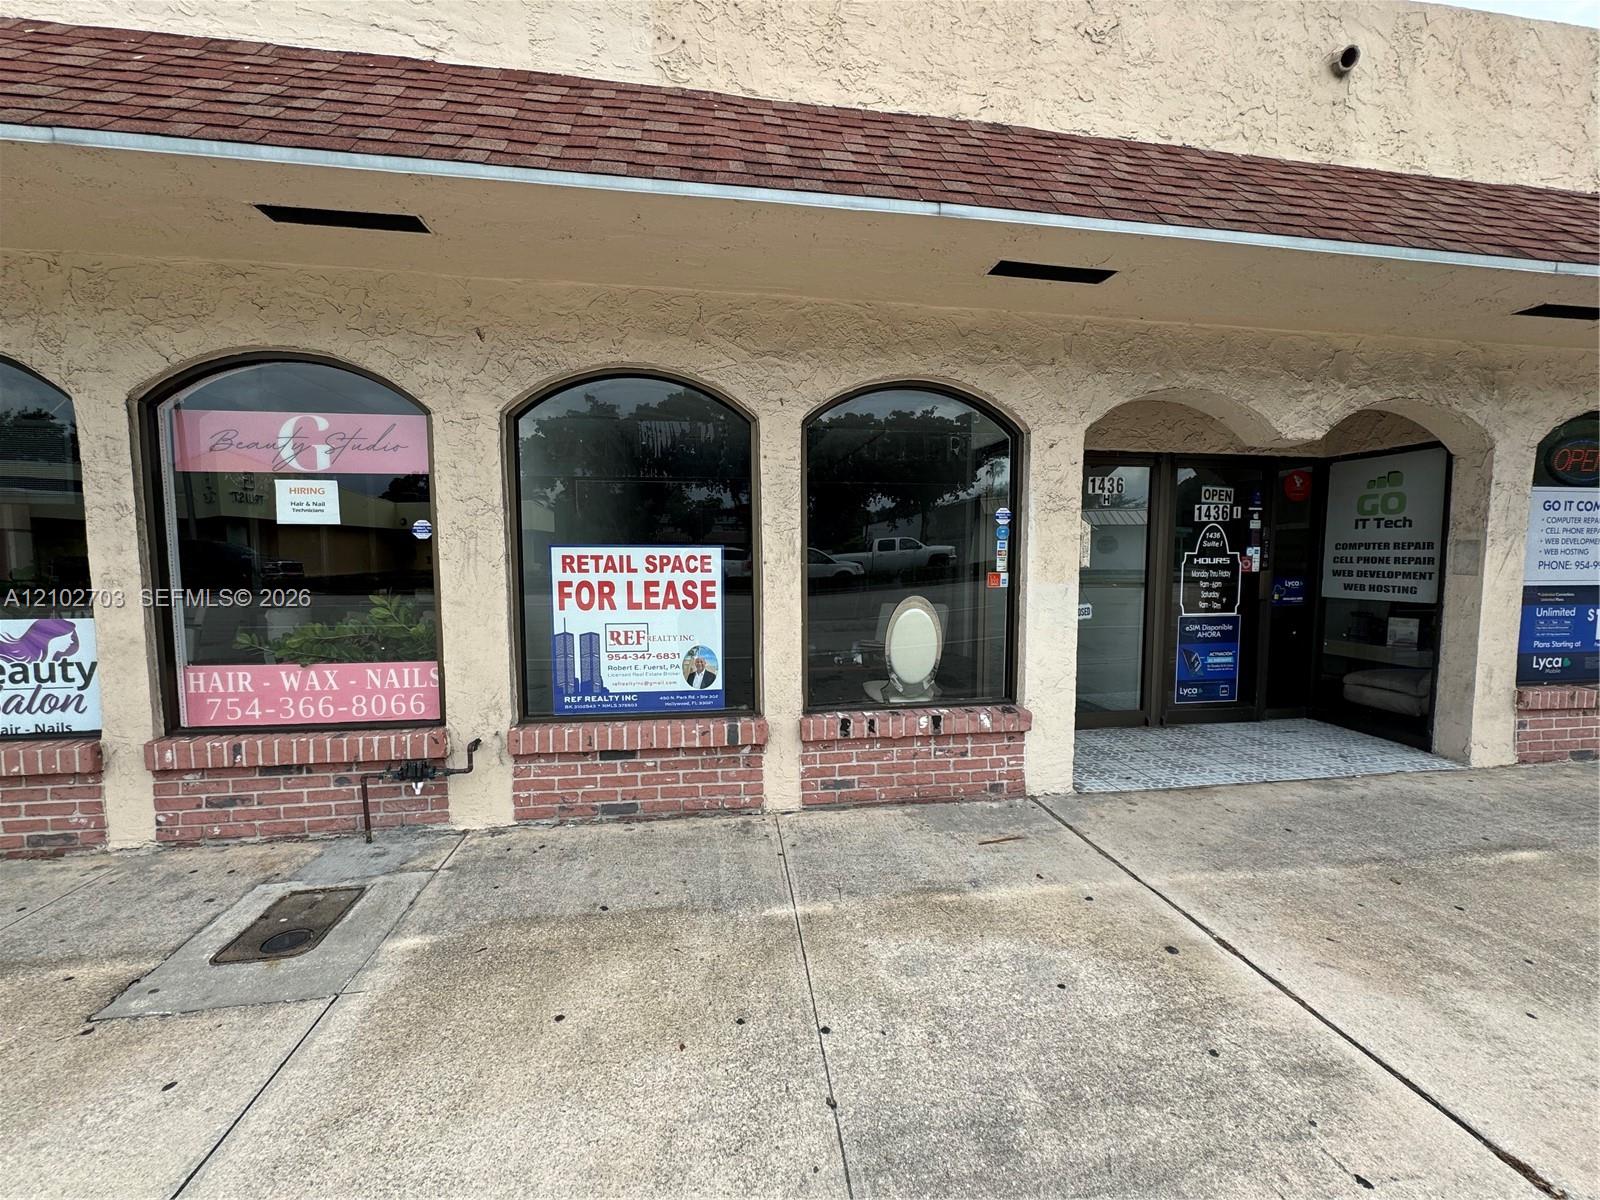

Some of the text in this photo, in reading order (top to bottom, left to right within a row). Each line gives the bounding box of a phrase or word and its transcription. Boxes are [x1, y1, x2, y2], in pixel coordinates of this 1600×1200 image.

[208, 423, 408, 472] Beauty Studio
[278, 415, 331, 472] G
[288, 486, 326, 496] HIRING
[1090, 477, 1124, 494] 1436
[1103, 494, 1110, 505] H
[1203, 488, 1232, 502] OPEN
[1357, 491, 1407, 516] GO
[1543, 500, 1561, 511] GO
[1564, 500, 1574, 511] IT
[1196, 505, 1229, 521] 1436
[1354, 516, 1413, 530] IT Tech
[1545, 527, 1560, 535] CELL
[1335, 541, 1435, 551] COMPUTER REPAIR
[1545, 537, 1559, 545] WEB
[561, 554, 712, 573] RETAIL SPACE
[1333, 556, 1435, 566] CELL PHONE REPAIR
[1538, 560, 1572, 570] PHONE:
[1191, 570, 1209, 579] Monday
[1332, 569, 1435, 580] WEB DEVELOPMENT
[1343, 583, 1418, 595] WEB HOSTING
[557, 579, 717, 611] FOR LEASE
[1201, 591, 1219, 599] Saturday
[1536, 607, 1576, 617] Unlimited
[1185, 623, 1233, 632] eSIM Disponible
[608, 630, 646, 646] REF
[677, 634, 695, 642] INC
[1533, 640, 1551, 648] Plans
[1551, 640, 1574, 649] Starting
[607, 652, 681, 661] 954-347-6831
[1532, 655, 1562, 671] Lyca
[0, 657, 98, 691] eauty
[188, 670, 254, 694] HAIR
[279, 669, 340, 692] WAX
[366, 667, 439, 689] NAILS
[1179, 687, 1198, 696] Lyca
[0, 683, 88, 716] alon
[564, 695, 583, 703] REF
[584, 695, 620, 703] REALTY
[206, 693, 426, 721] 754-366-8066
[0, 723, 21, 735] air
[35, 722, 73, 734] Nails
